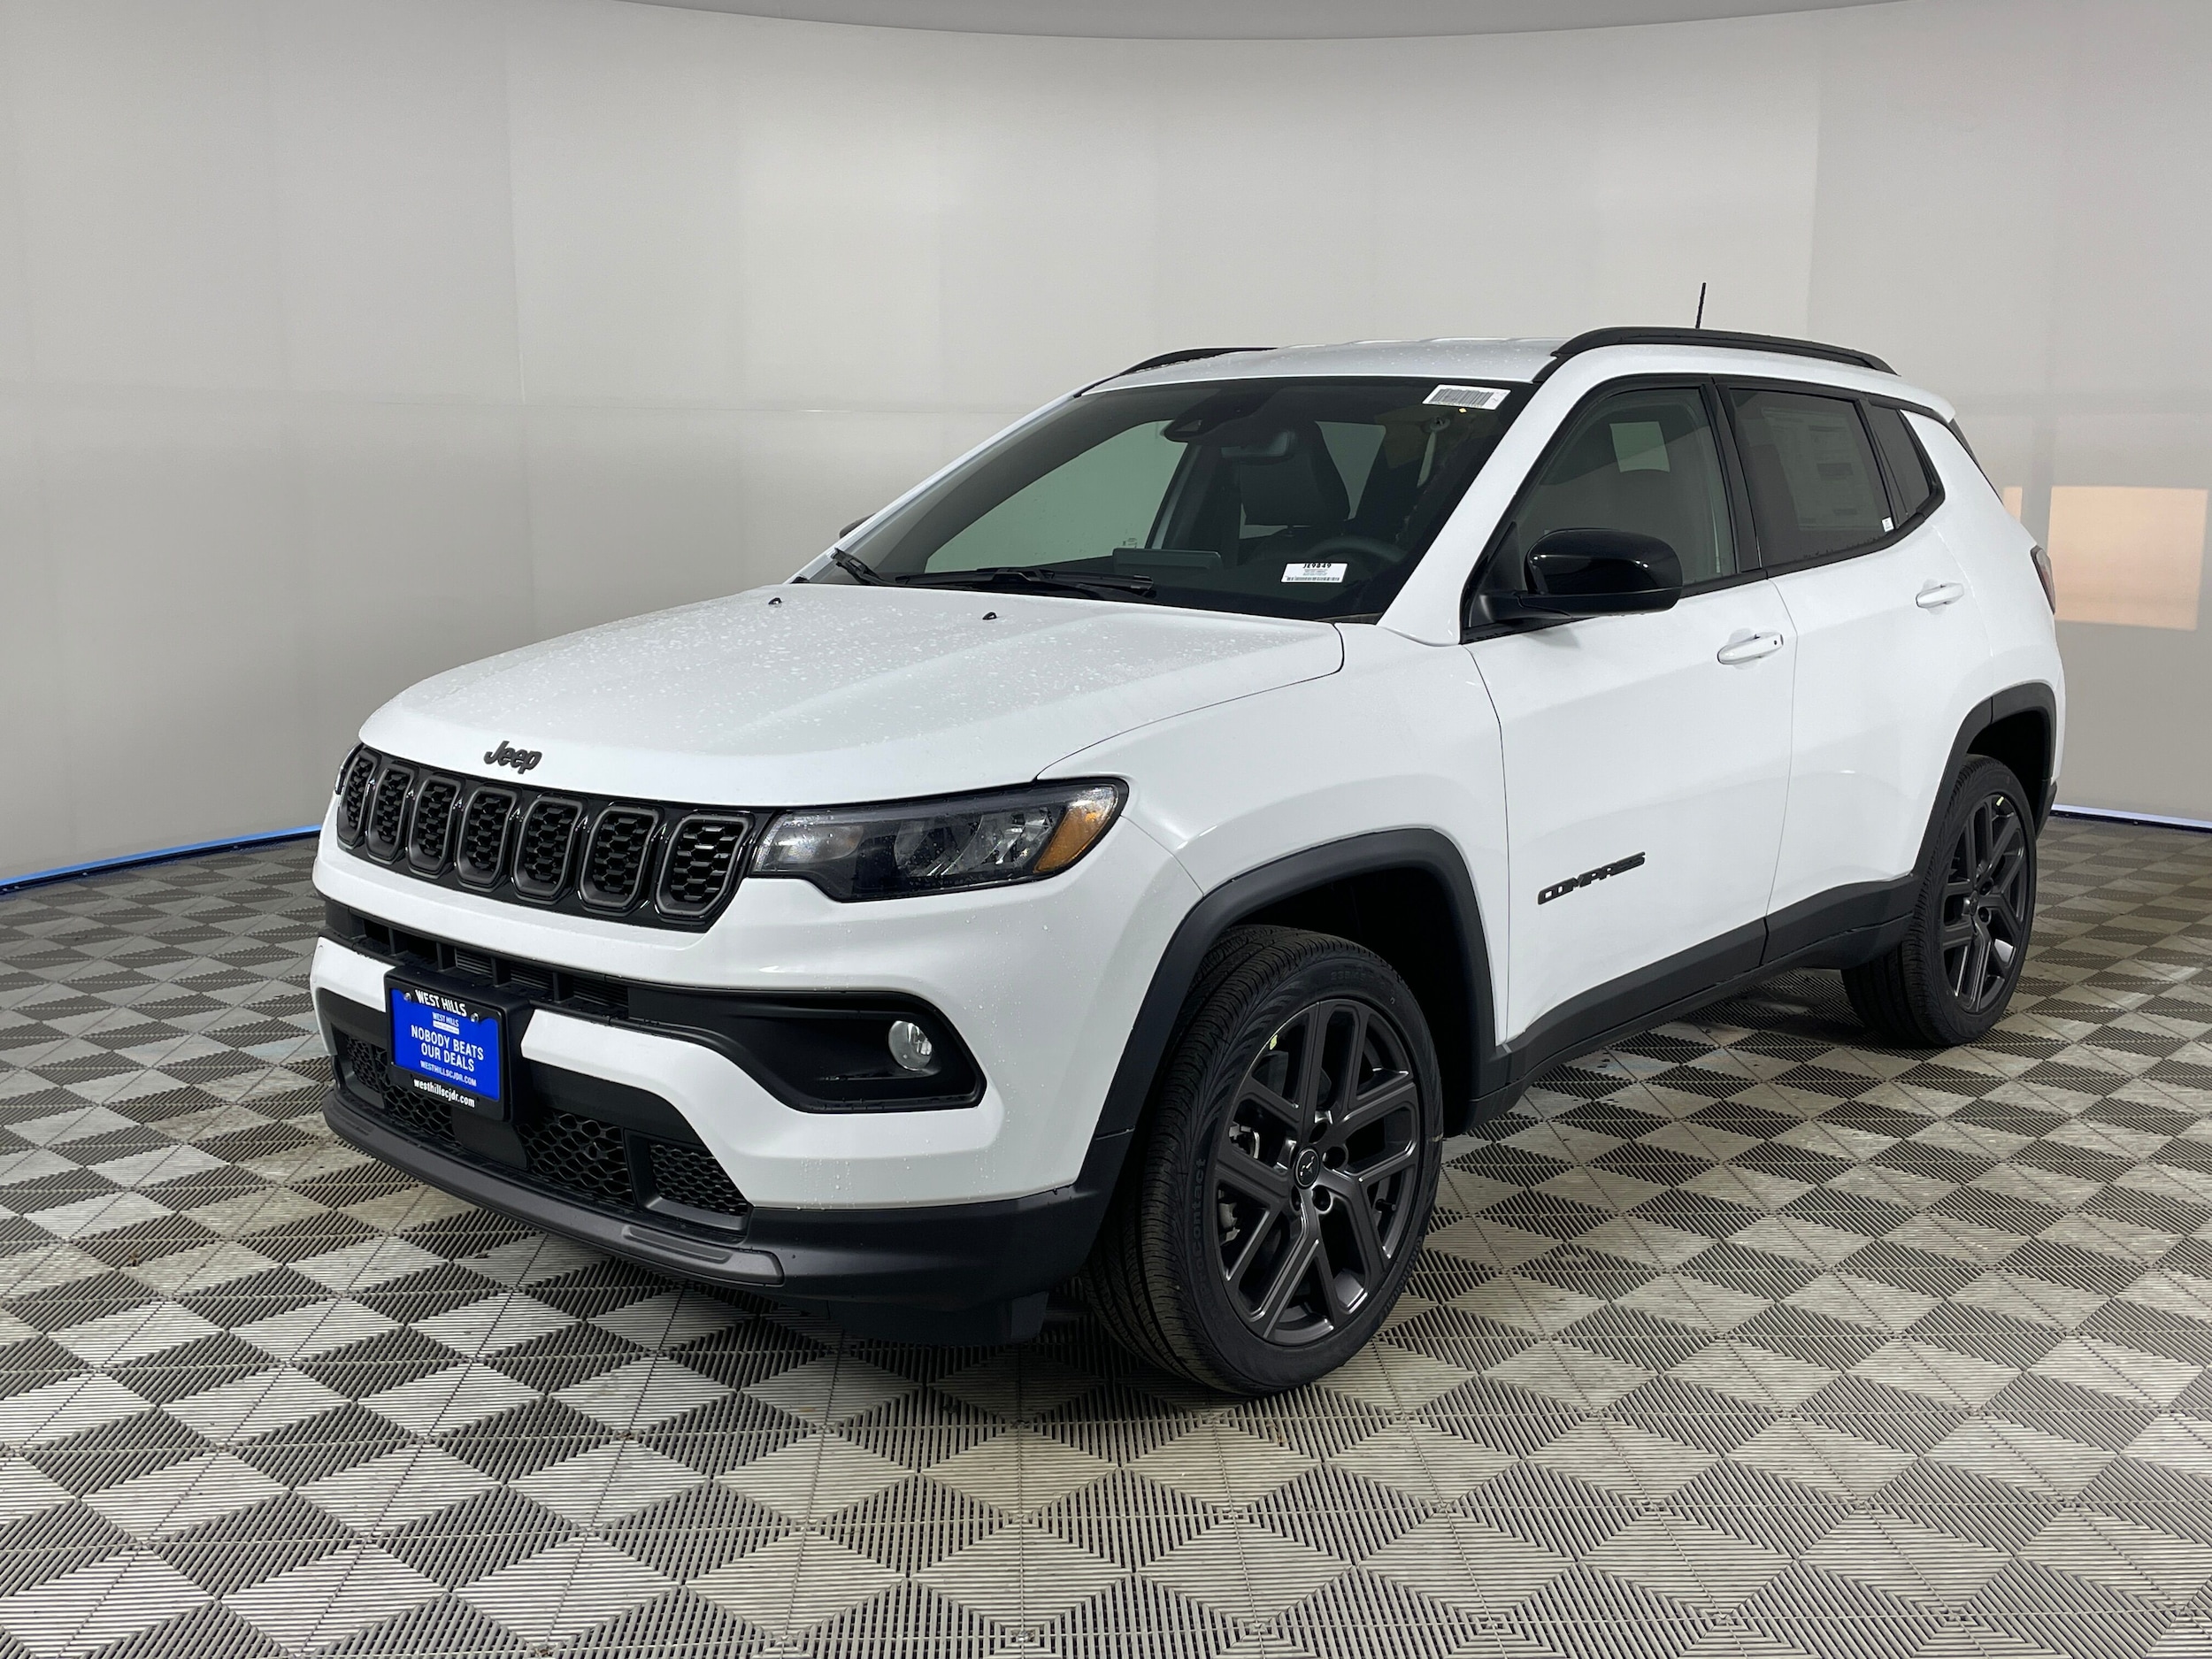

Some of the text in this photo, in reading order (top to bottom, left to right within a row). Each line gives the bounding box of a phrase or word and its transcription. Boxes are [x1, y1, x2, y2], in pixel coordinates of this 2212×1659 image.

[483, 740, 542, 774] Jeep
[1538, 851, 1646, 905] COMPASS
[415, 989, 467, 1017] WEST HILLS
[432, 1011, 446, 1023] WEST
[445, 1016, 459, 1027] HILLS
[411, 1025, 450, 1048] NOBODY
[453, 1037, 484, 1061] BEATS
[421, 1043, 474, 1072] OUR DEALS
[419, 1060, 477, 1087] WESTHILLSCJDR.COM
[413, 1079, 475, 1108] westhillscjdr.com
